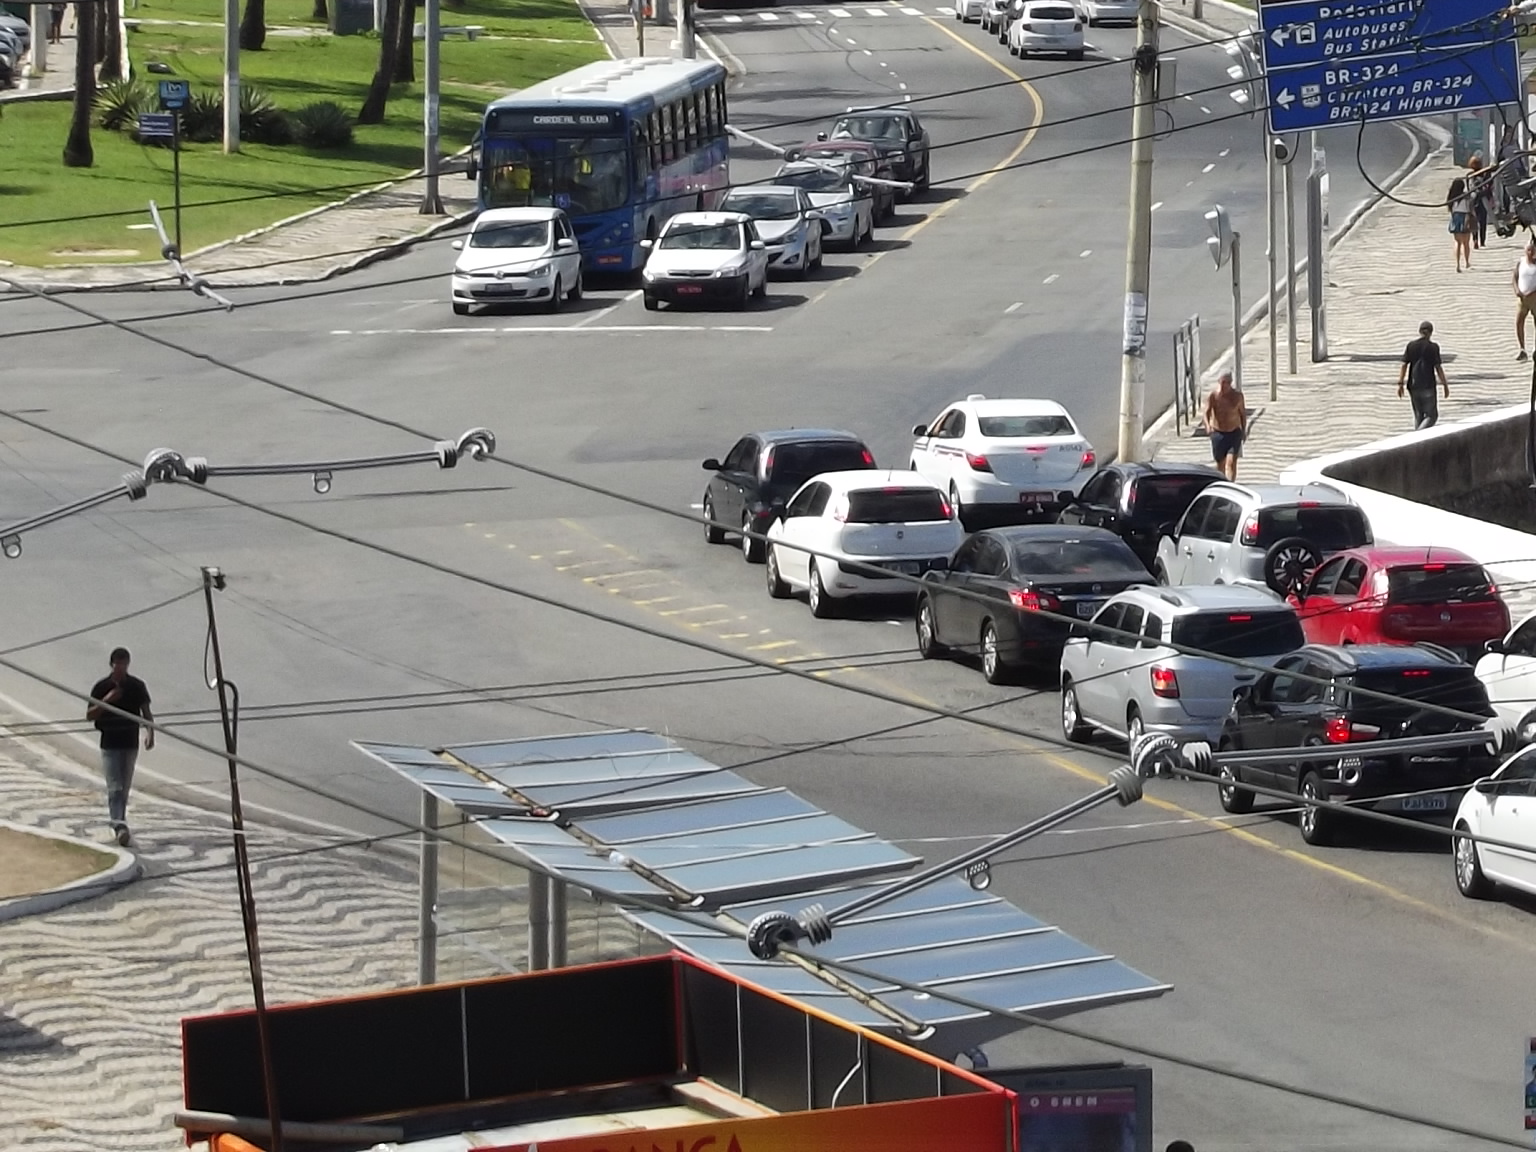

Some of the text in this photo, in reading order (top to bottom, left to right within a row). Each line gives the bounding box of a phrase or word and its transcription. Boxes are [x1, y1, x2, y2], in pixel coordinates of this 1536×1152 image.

[1323, 20, 1407, 40] Autobuses
[1324, 42, 1353, 56] Bus
[1325, 63, 1399, 85] BR-324
[1412, 74, 1473, 94] BR-324
[1398, 93, 1463, 111] Highway
[533, 115, 609, 124] CARDEAL SILVA
